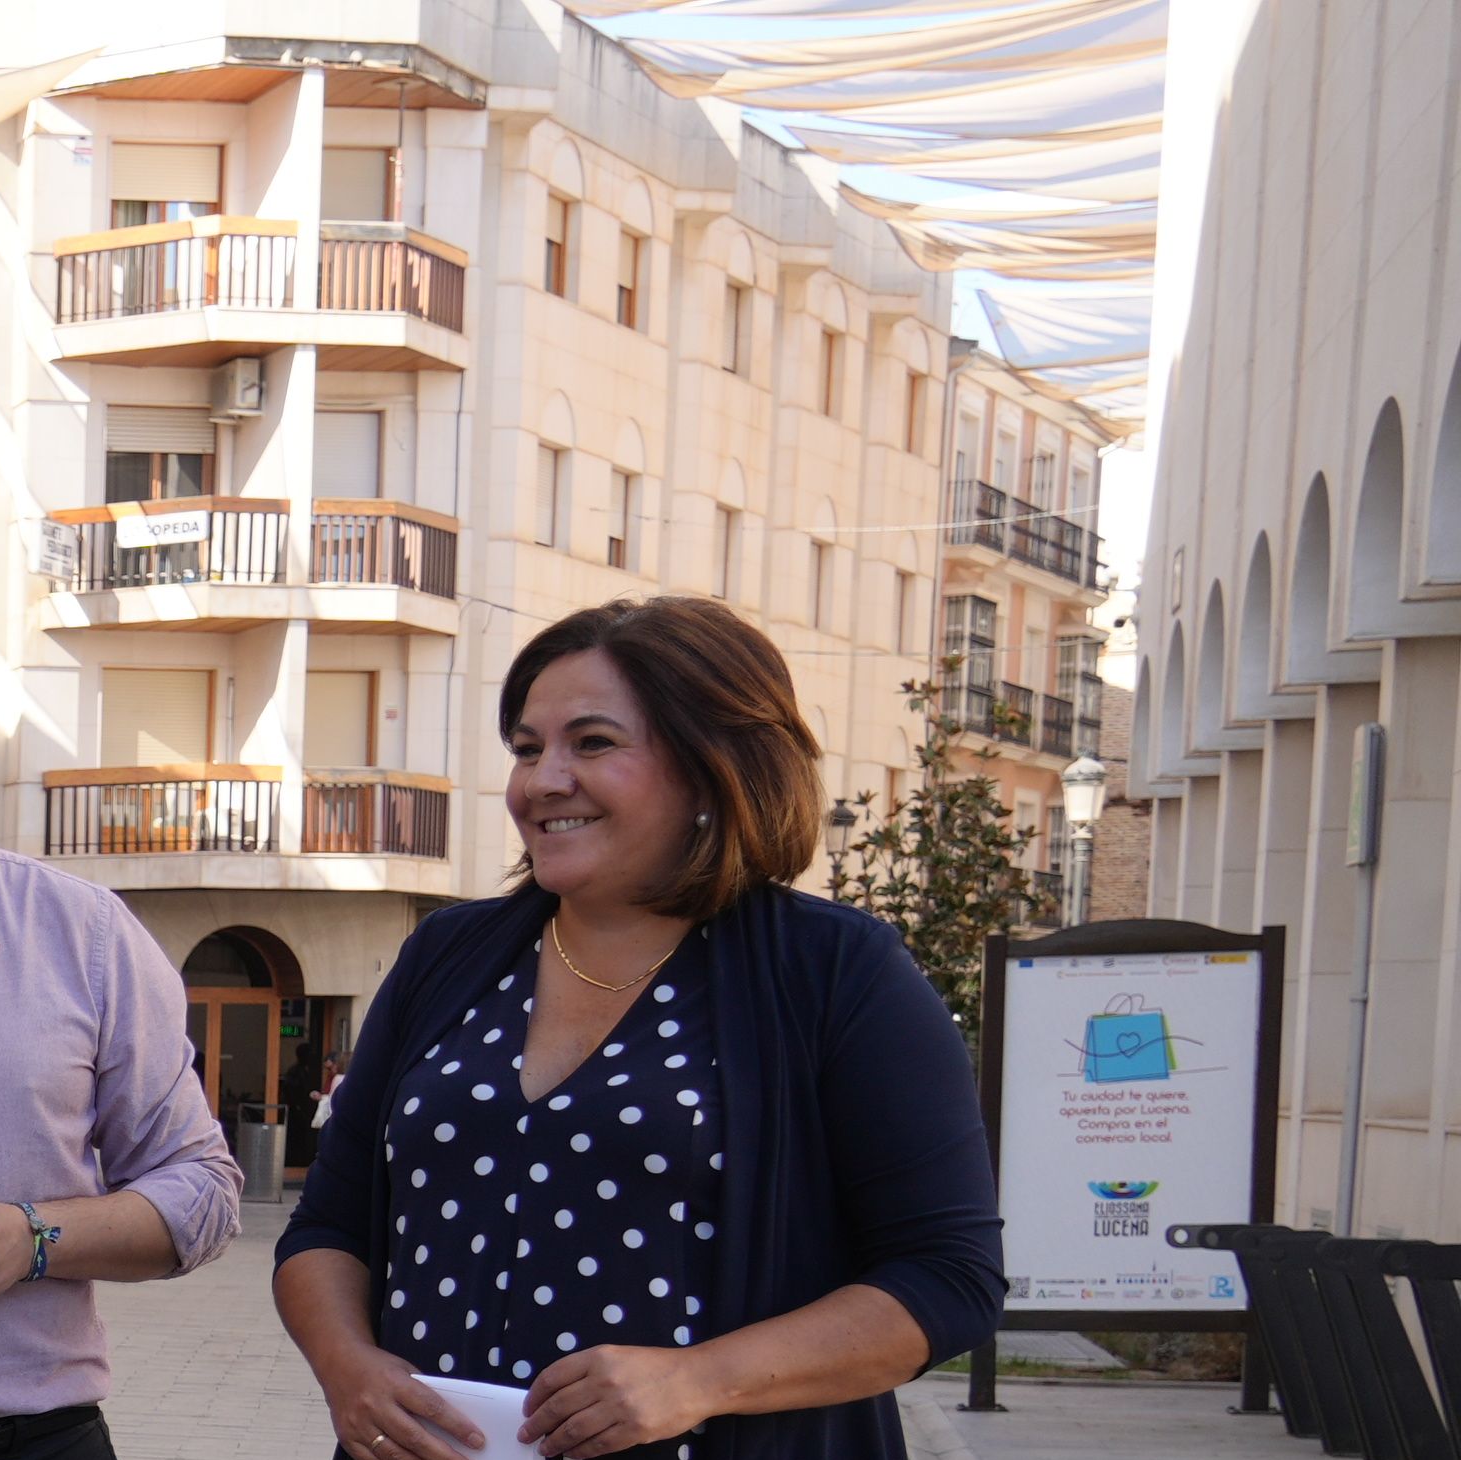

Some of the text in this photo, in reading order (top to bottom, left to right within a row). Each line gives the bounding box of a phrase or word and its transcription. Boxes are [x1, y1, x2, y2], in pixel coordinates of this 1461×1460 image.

[1062, 1091, 1077, 1101] Tu
[1081, 1090, 1124, 1101] ciudad
[1129, 1090, 1142, 1101] te
[1059, 1105, 1110, 1118] apuesta
[1114, 1106, 1136, 1117] por
[1078, 1117, 1167, 1131] Compra en el
[1076, 1133, 1135, 1144] comercio
[1094, 1219, 1149, 1237] LUCENA
